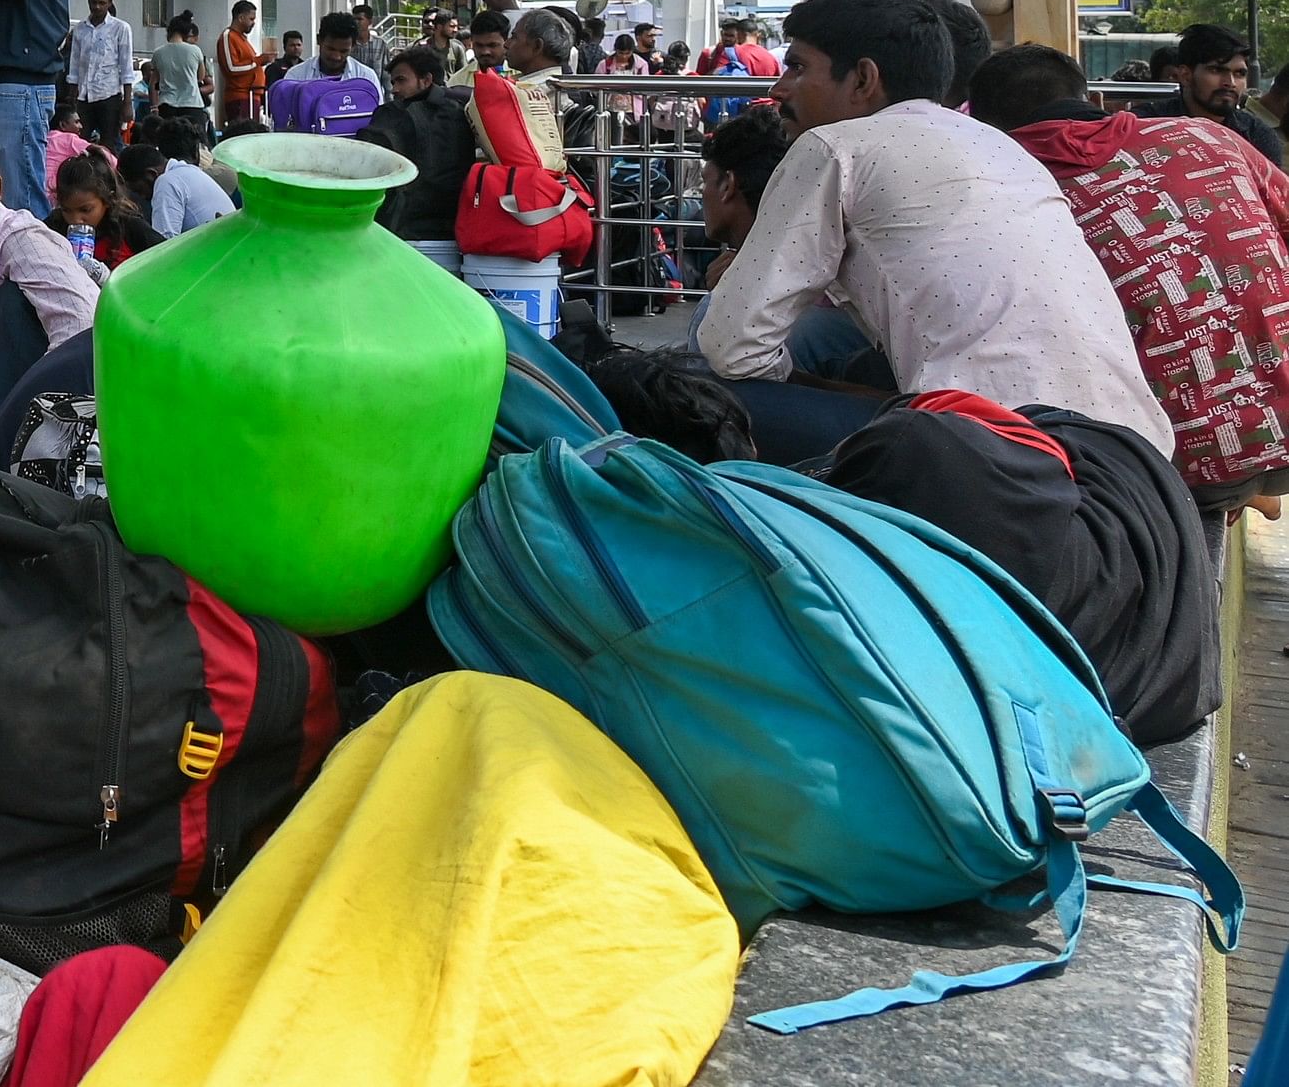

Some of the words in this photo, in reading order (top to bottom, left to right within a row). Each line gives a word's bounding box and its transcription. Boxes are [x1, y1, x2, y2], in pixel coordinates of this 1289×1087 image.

[1098, 191, 1125, 209] JUST
[1145, 250, 1171, 267] JUST
[1184, 324, 1208, 341] JUST
[1207, 401, 1233, 418] JUST
